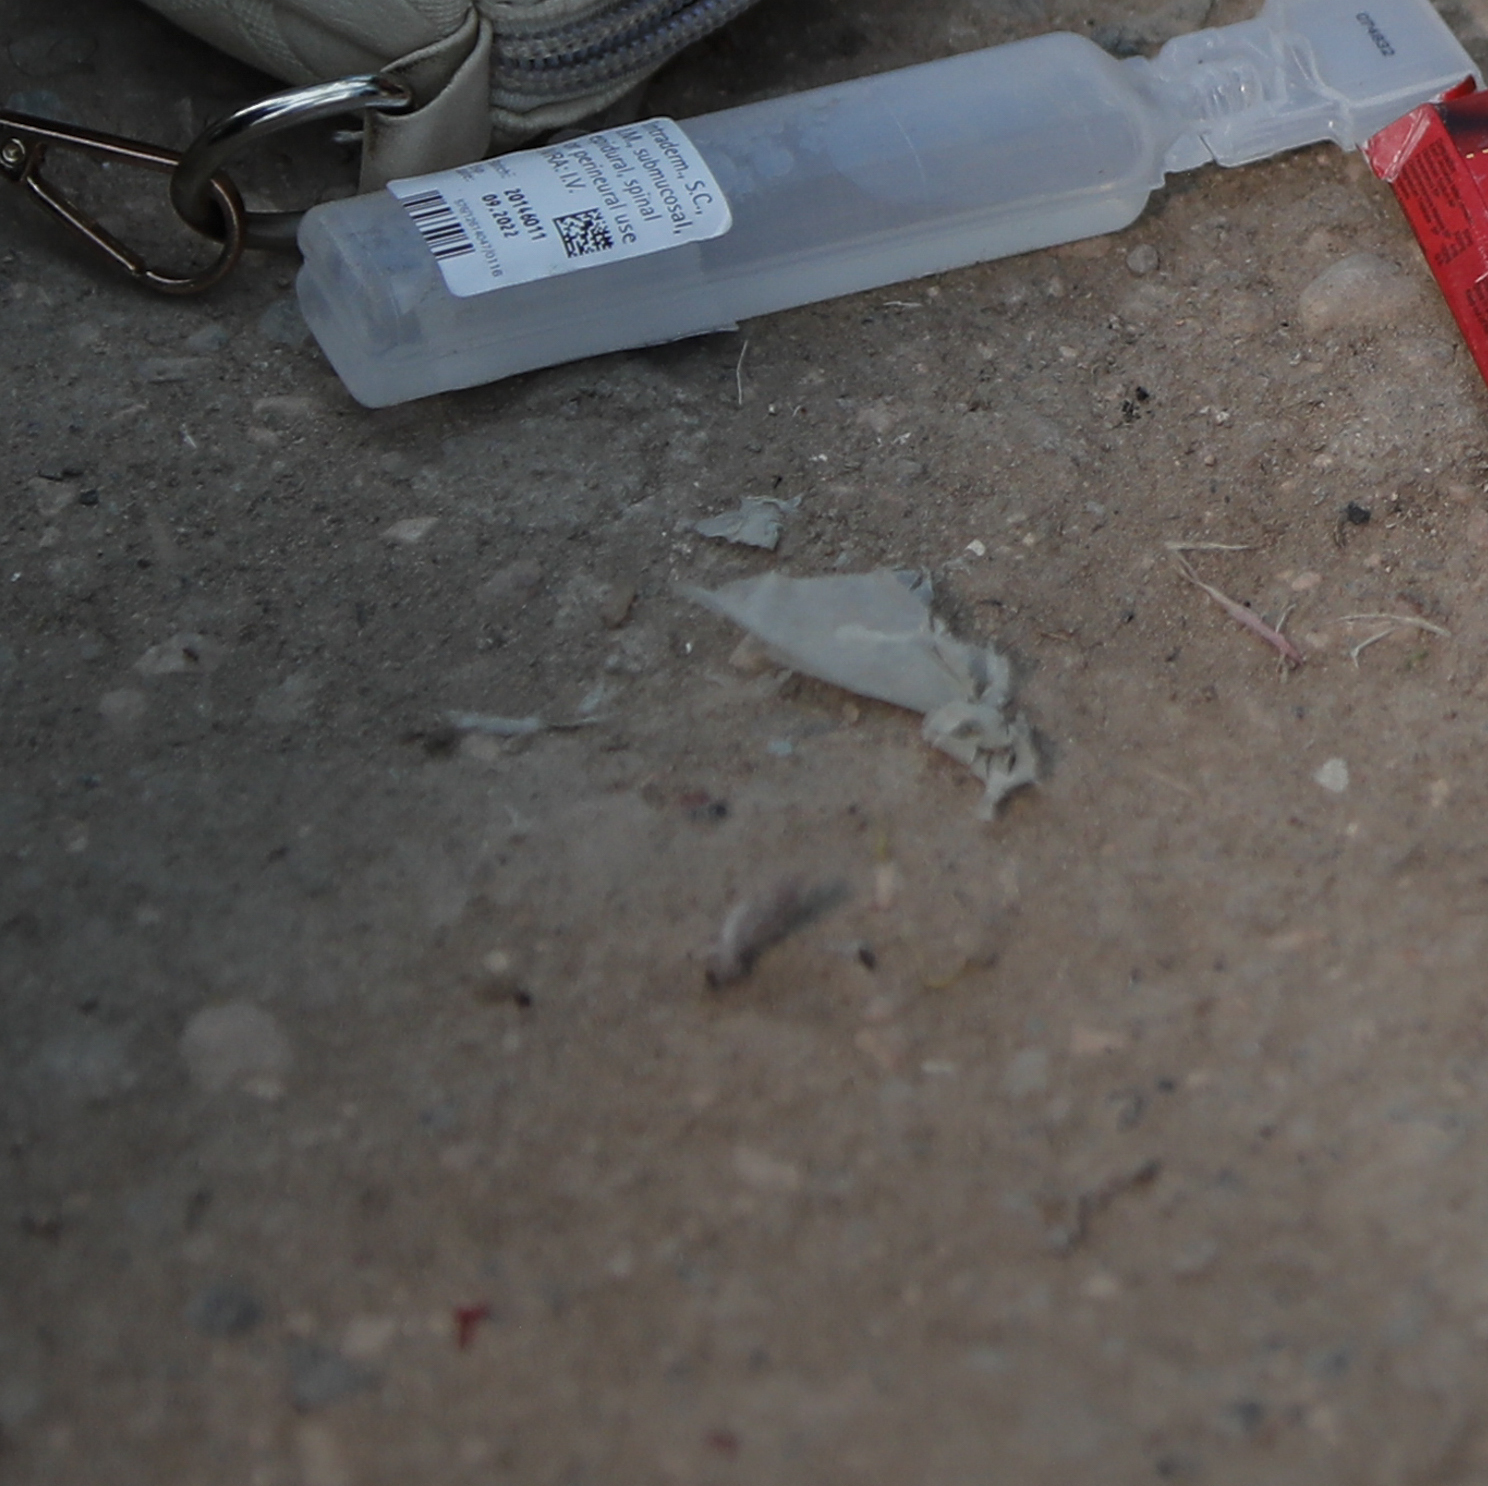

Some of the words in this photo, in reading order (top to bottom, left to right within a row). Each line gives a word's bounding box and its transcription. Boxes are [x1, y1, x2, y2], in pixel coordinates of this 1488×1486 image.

[558, 170, 585, 194] I.V.
[571, 148, 626, 211] perineural
[613, 213, 638, 245] use
[622, 177, 661, 223] spinal
[632, 146, 693, 236] submucosal,
[683, 178, 715, 216] S.C.,
[480, 192, 519, 239] 09.2022
[502, 187, 547, 242] 20146011
